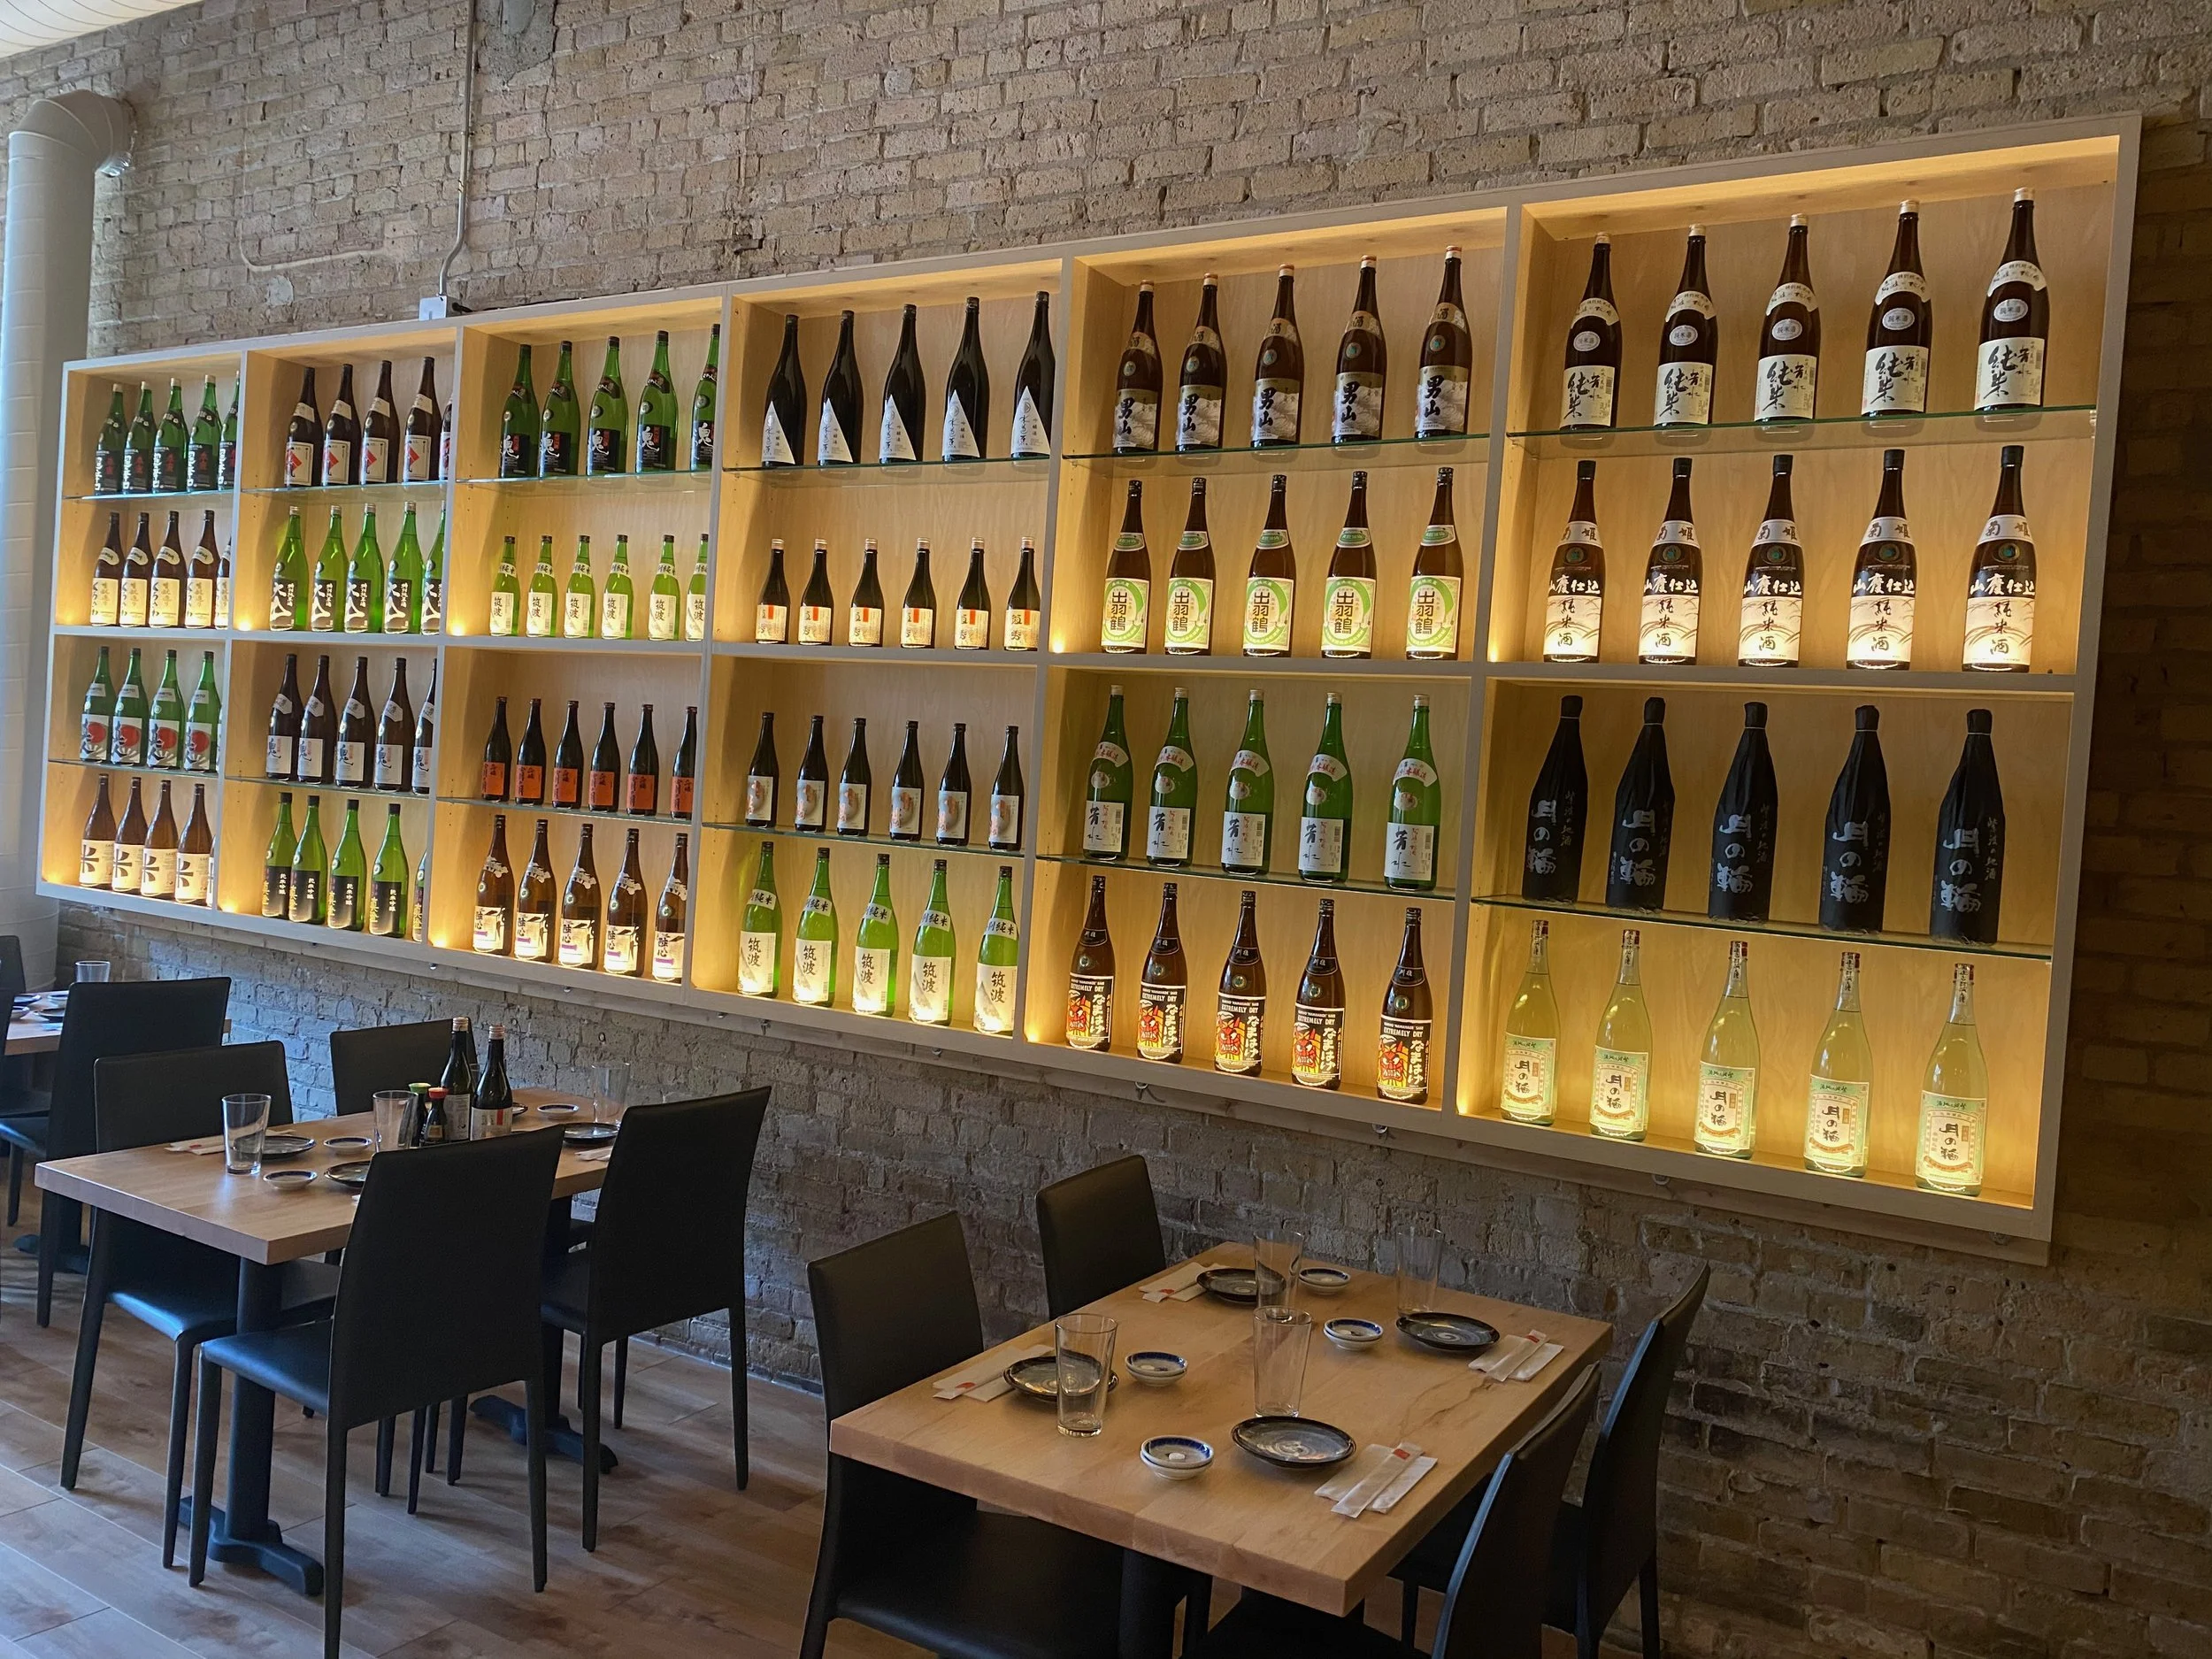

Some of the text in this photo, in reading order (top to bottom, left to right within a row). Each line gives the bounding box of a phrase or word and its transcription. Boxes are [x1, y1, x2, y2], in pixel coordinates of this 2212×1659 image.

[1259, 387, 1278, 428] 男山
[1341, 380, 1360, 423] 男山
[1424, 374, 1445, 418] 男山
[1118, 396, 1135, 436] 男山
[1182, 393, 1200, 434] 男山
[592, 430, 609, 455] 鬼
[641, 426, 660, 452] 鬼
[1110, 591, 1128, 632] 出羽鶴
[1172, 591, 1190, 632] 出羽鶴
[1252, 591, 1271, 634] 出羽鶴
[1334, 591, 1355, 634] 出羽鶴
[1415, 591, 1435, 634] 出羽鶴
[747, 938, 762, 967] 筑波
[803, 945, 817, 976] 筑波
[861, 953, 874, 985] 筑波
[922, 962, 937, 994] 筑波
[990, 971, 1006, 1003] 筑波
[1071, 984, 1092, 993] EXTREMELY
[1141, 993, 1165, 1002] EXTREMELY
[1297, 1015, 1335, 1026] EXTREMELY DRY
[1383, 1028, 1410, 1037] EXTREMELY
